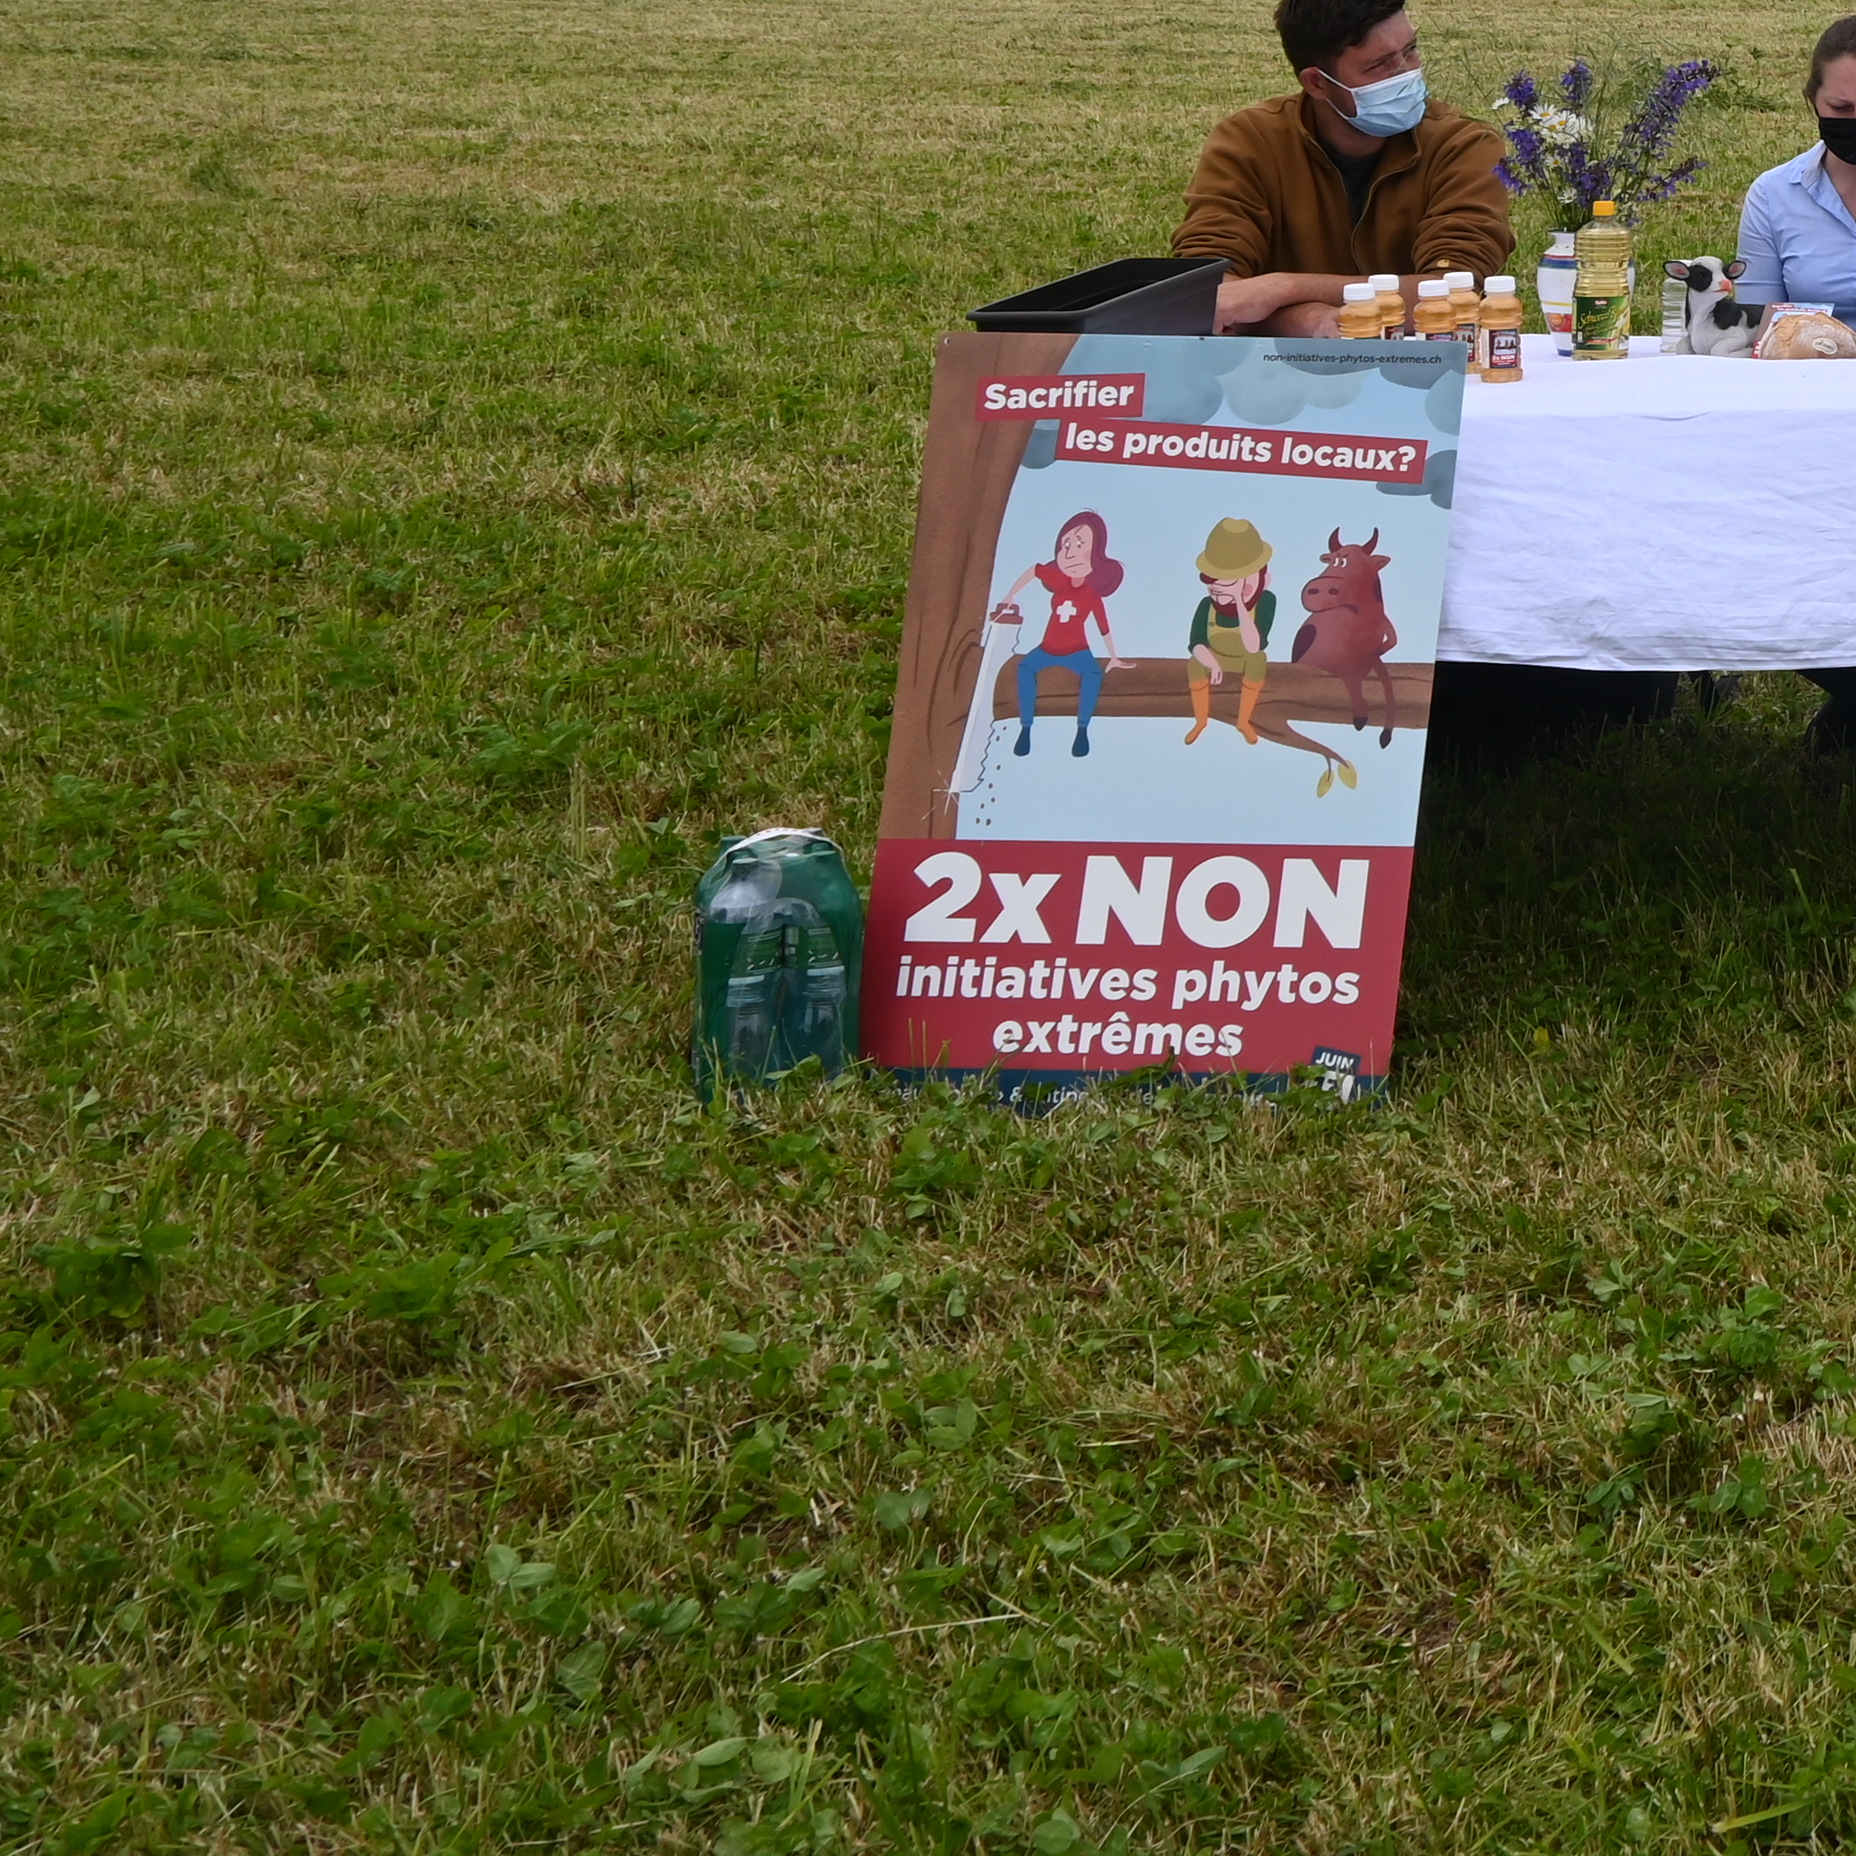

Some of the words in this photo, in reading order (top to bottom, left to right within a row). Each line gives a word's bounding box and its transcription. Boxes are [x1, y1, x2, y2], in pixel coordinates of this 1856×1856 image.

[1263, 352, 1442, 364] non-initiatives-phytos-extremes.ch
[983, 379, 1136, 411] Sacrifier
[1065, 422, 1115, 452] les
[1122, 431, 1273, 463] produits
[1280, 436, 1417, 472] locaux?
[904, 851, 1062, 944] 2x
[1075, 855, 1370, 949] NON
[896, 955, 1158, 1001] initiatives
[1171, 959, 1360, 1011] phytos
[992, 1011, 1244, 1057] extrêmes
[1315, 1051, 1355, 1070] JUIN
